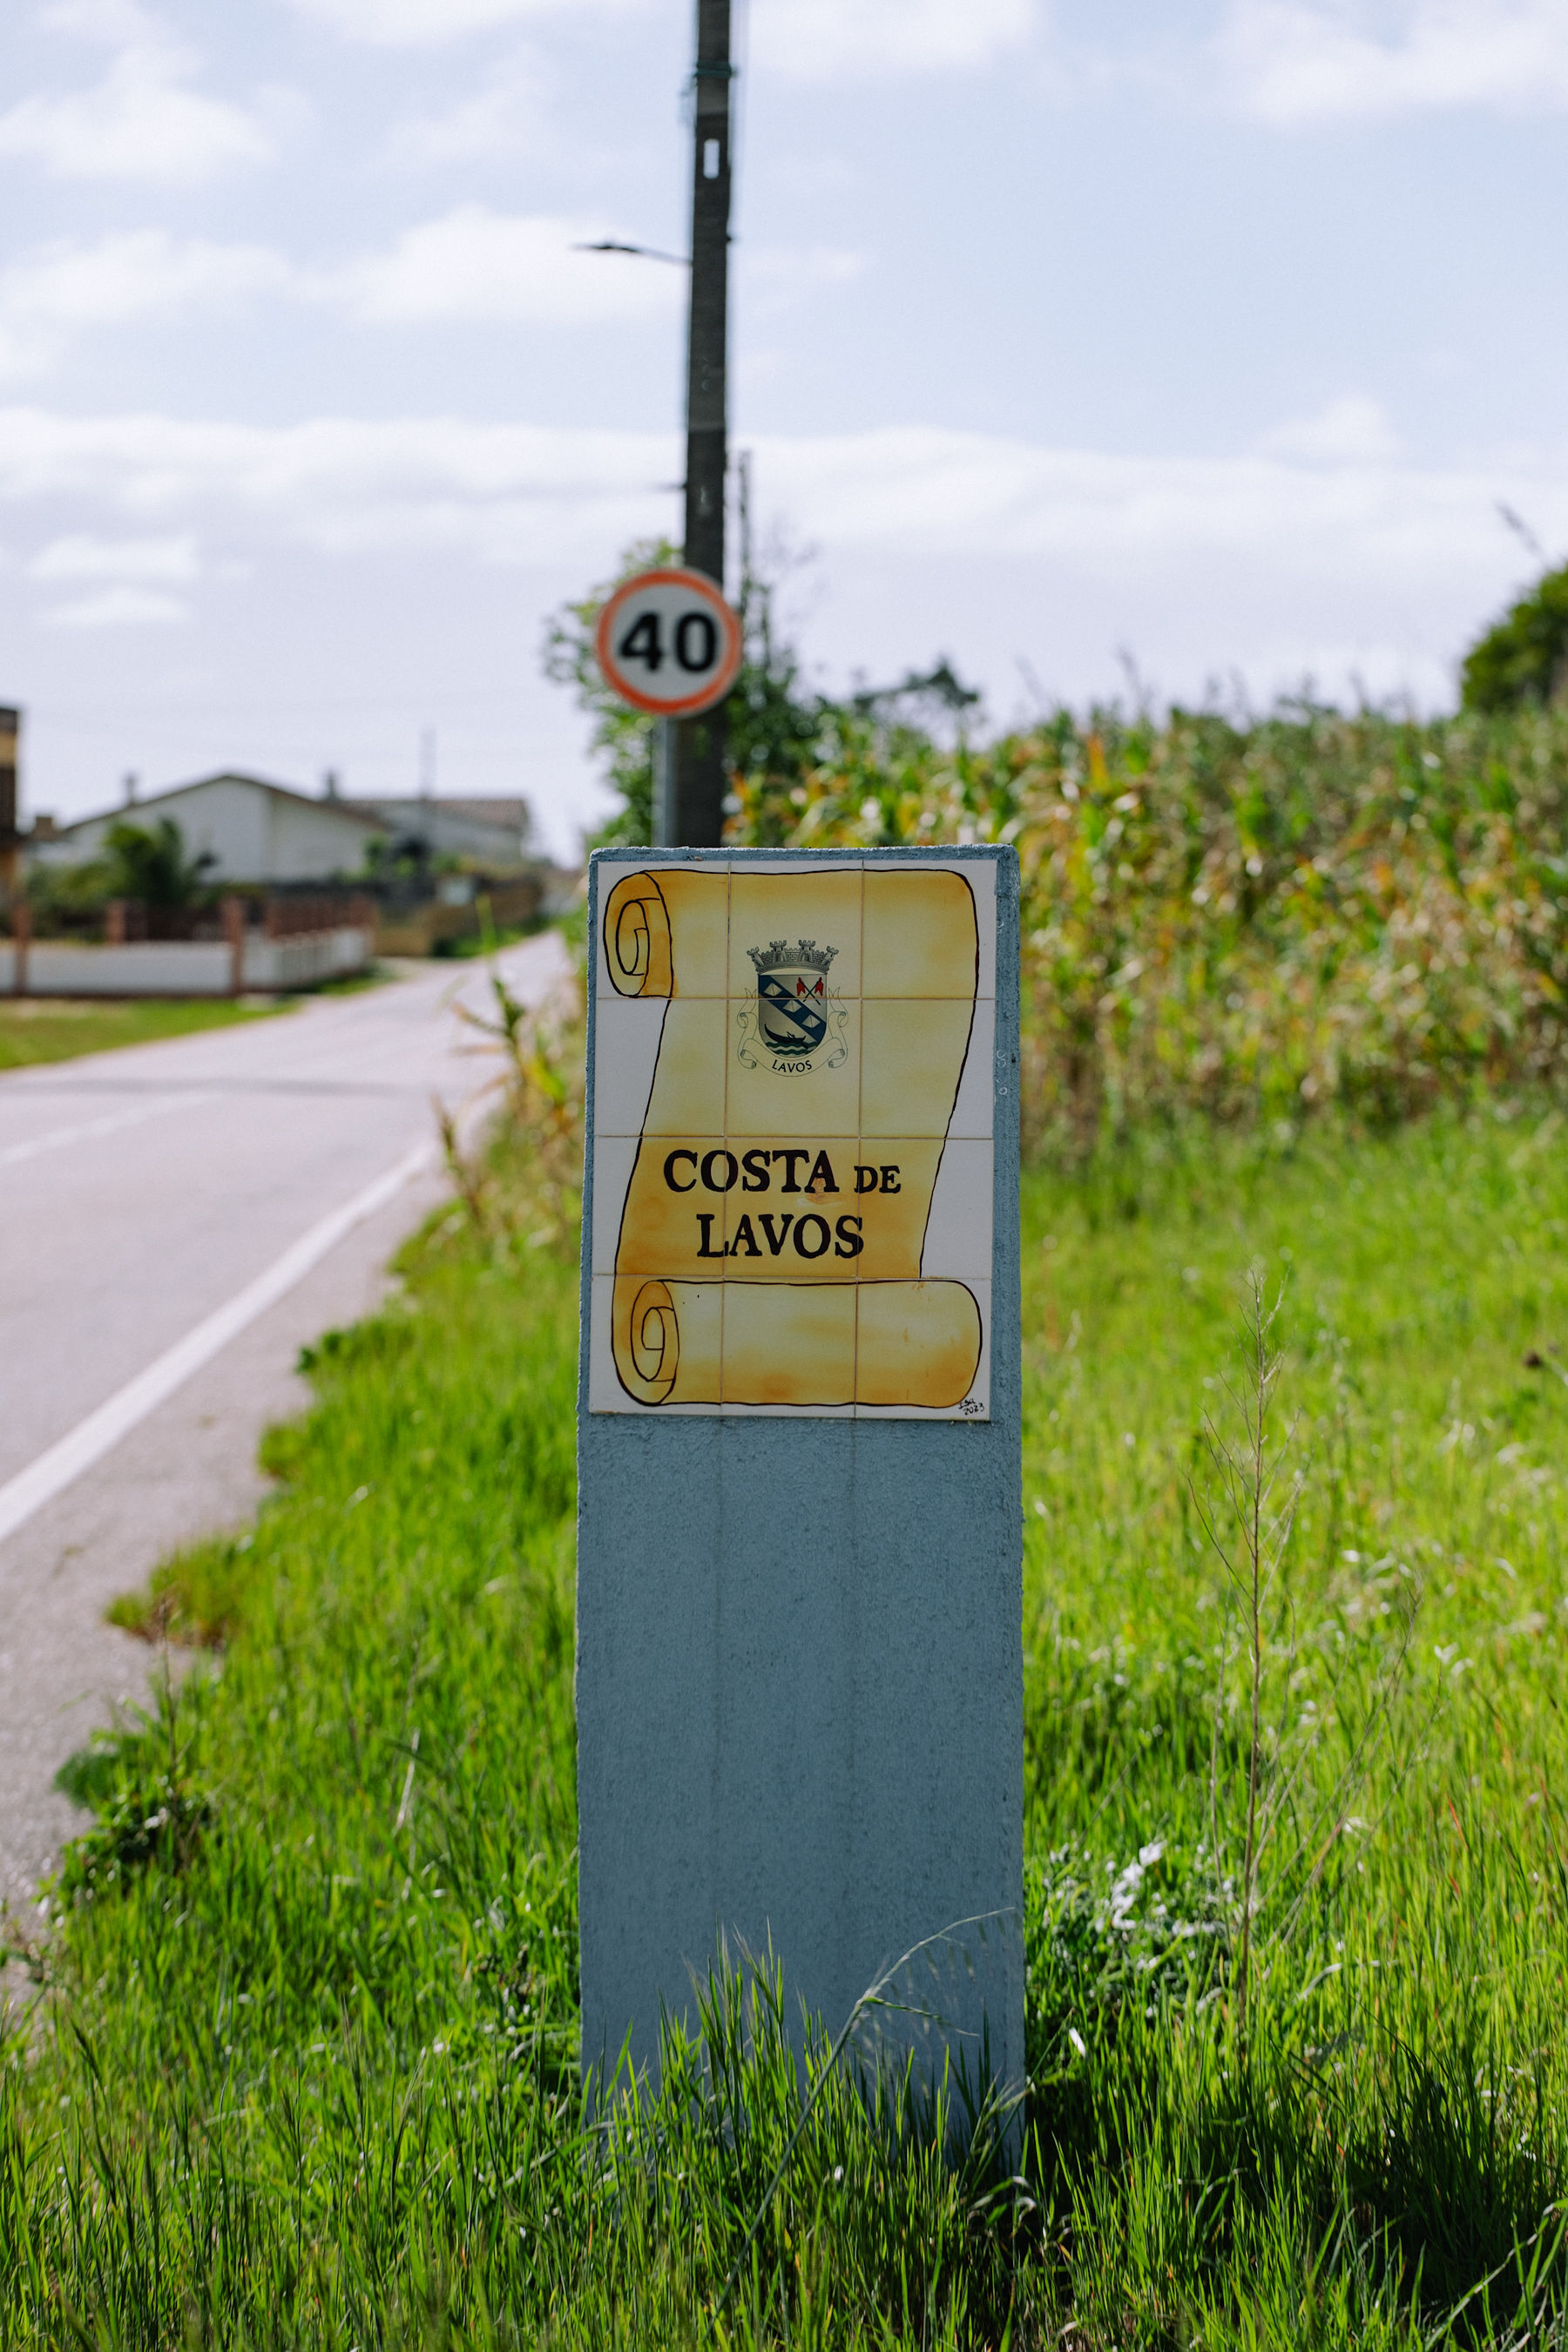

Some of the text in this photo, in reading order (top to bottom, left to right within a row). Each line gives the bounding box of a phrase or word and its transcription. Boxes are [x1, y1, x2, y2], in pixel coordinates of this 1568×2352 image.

[618, 611, 720, 674] 40
[772, 1058, 813, 1073] LAVOS
[664, 1149, 902, 1194] COSTA DE
[696, 1213, 864, 1259] LAVOS
